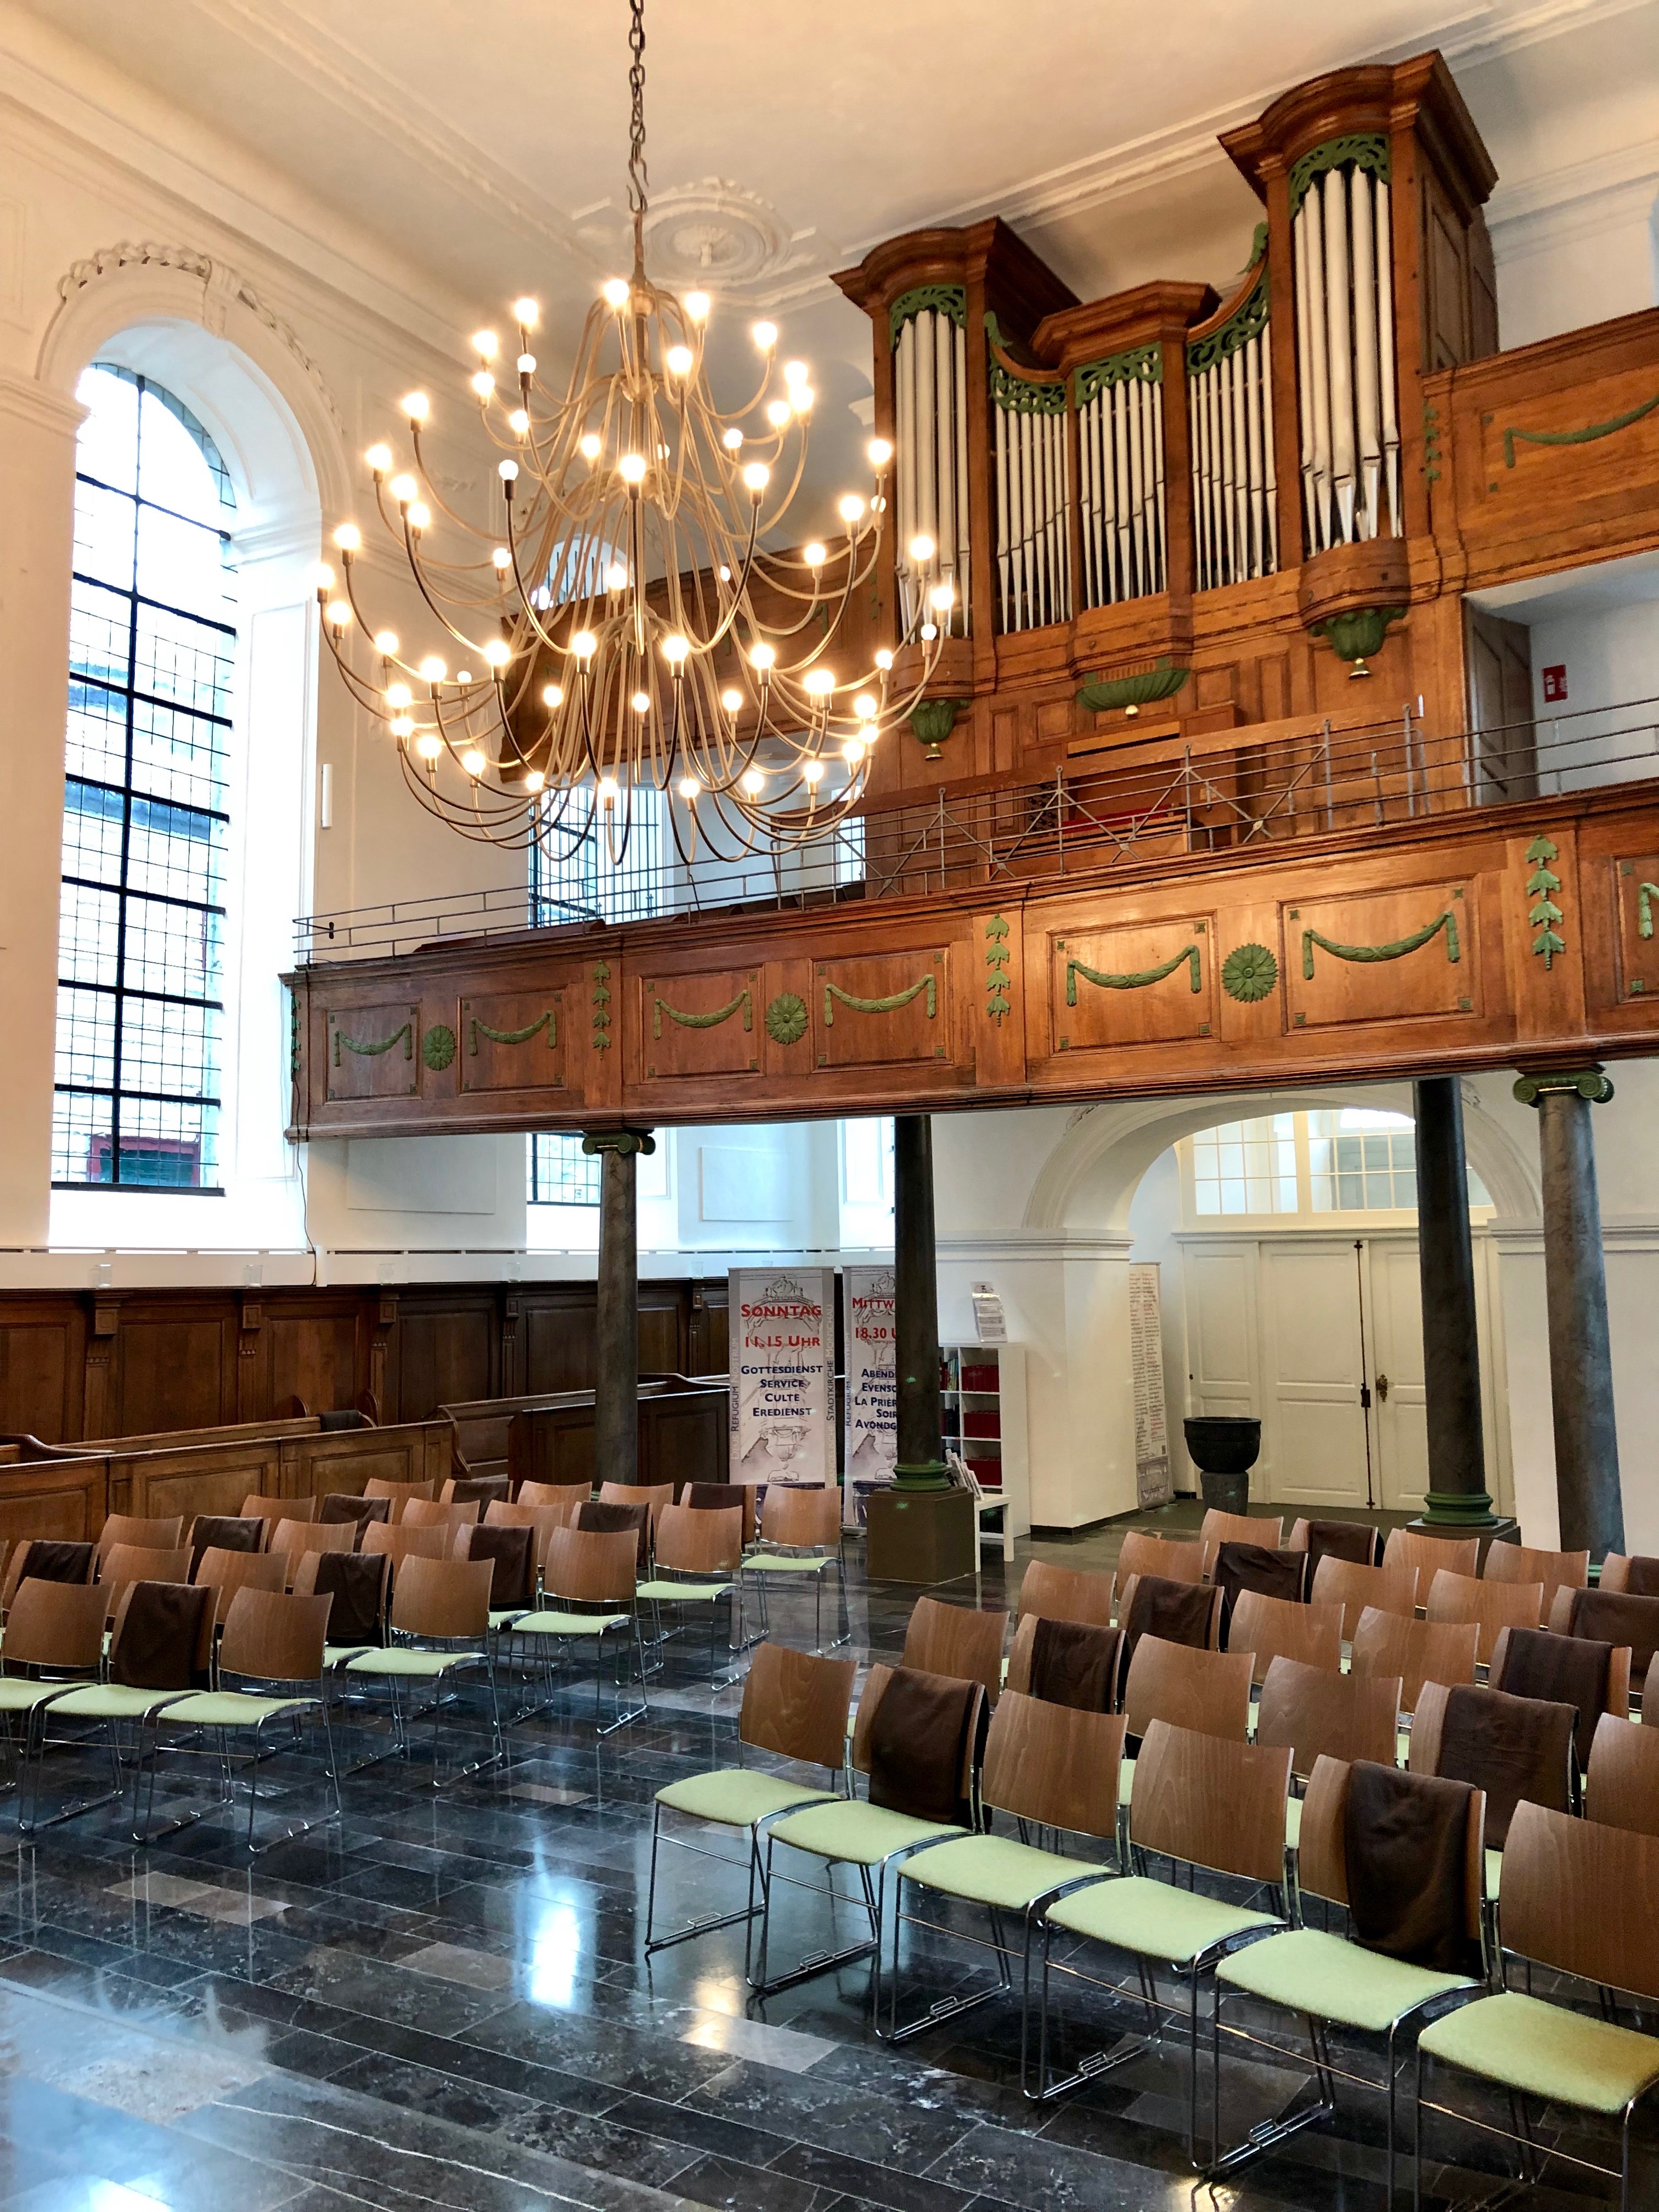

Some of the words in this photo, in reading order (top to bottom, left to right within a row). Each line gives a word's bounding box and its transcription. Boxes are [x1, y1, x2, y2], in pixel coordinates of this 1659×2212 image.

[741, 1304, 822, 1317] SONNTAG
[825, 1304, 834, 1357] MONSCHAU
[855, 1327, 887, 1339] 18.30
[745, 1335, 782, 1347] 11.15
[788, 1335, 821, 1347] UHR
[731, 1338, 739, 1384] NOSTRUM
[741, 1365, 823, 1375] GOTTESDIENST
[760, 1379, 804, 1388] SERVICE
[826, 1361, 834, 1421] STADTKIRCHE
[765, 1393, 800, 1402] CULTE
[854, 1396, 868, 1406] LA
[731, 1386, 739, 1432] REFUGIUM
[753, 1408, 812, 1417] EREDIENST
